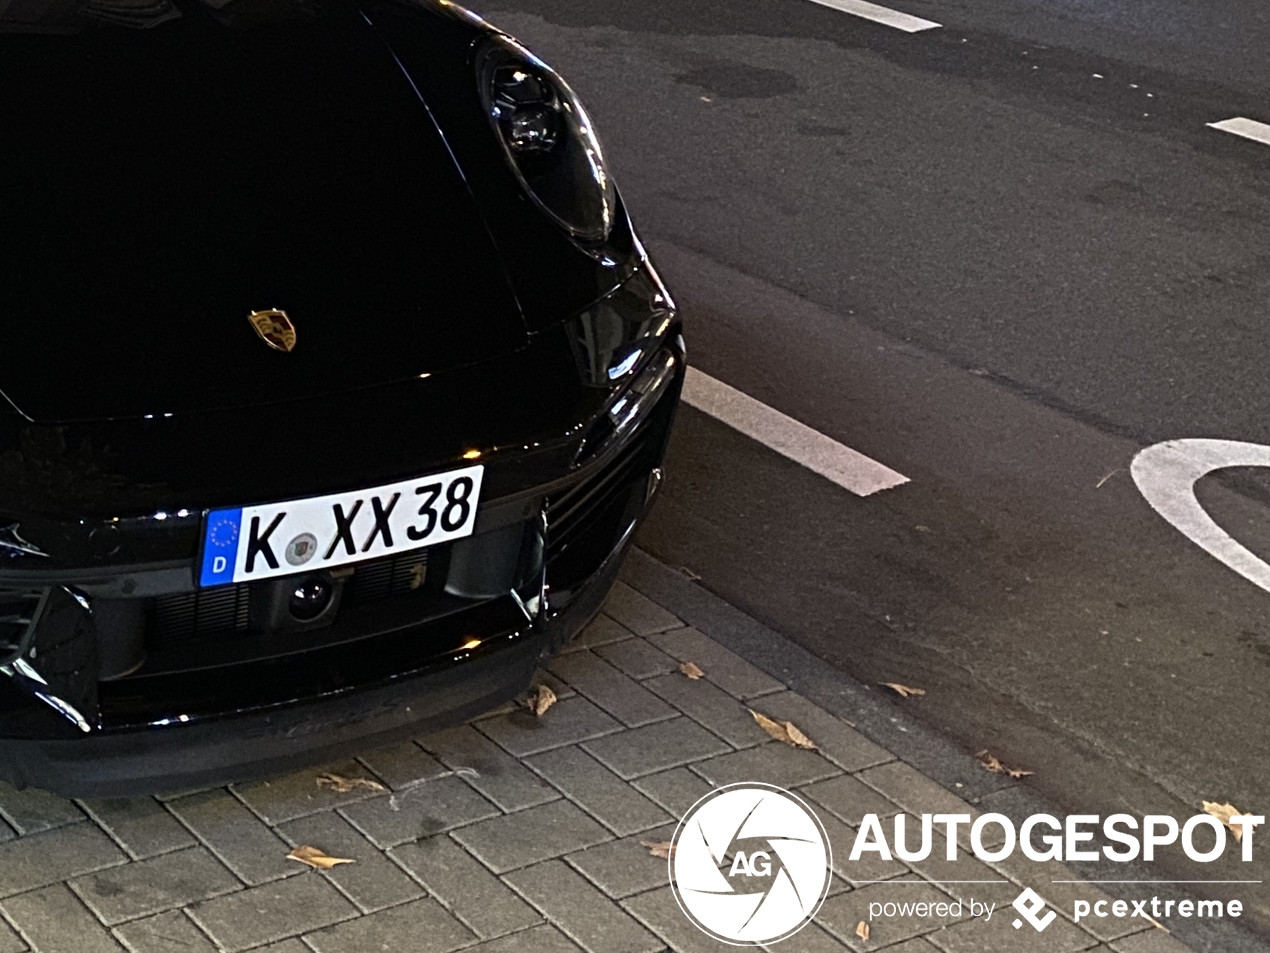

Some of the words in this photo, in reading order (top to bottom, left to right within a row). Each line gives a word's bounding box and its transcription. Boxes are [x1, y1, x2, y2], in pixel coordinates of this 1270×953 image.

[245, 512, 287, 573] K
[324, 492, 401, 560] XX
[407, 476, 474, 541] 38
[213, 557, 226, 573] D
